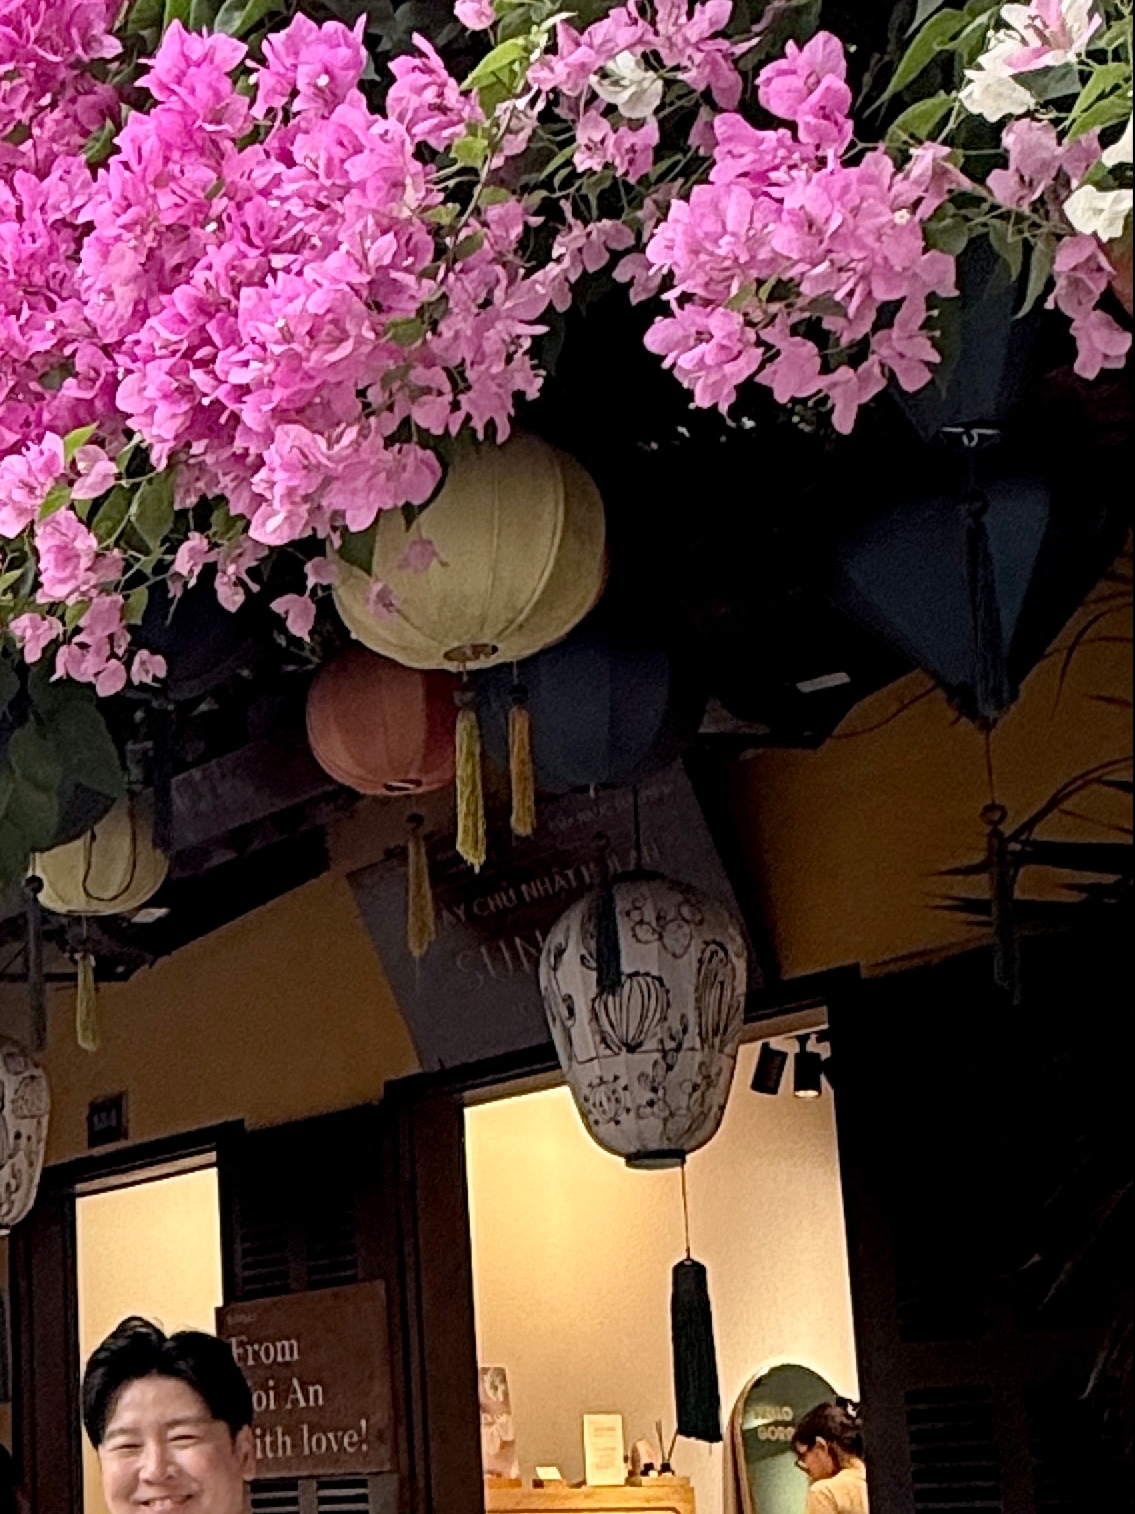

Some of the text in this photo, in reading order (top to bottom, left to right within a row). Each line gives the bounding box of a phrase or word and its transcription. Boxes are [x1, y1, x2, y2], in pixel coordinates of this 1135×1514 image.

[456, 928, 544, 989] SUN
[229, 1335, 300, 1367] From
[253, 1377, 325, 1412] oi An
[254, 1419, 369, 1459] ith love!
